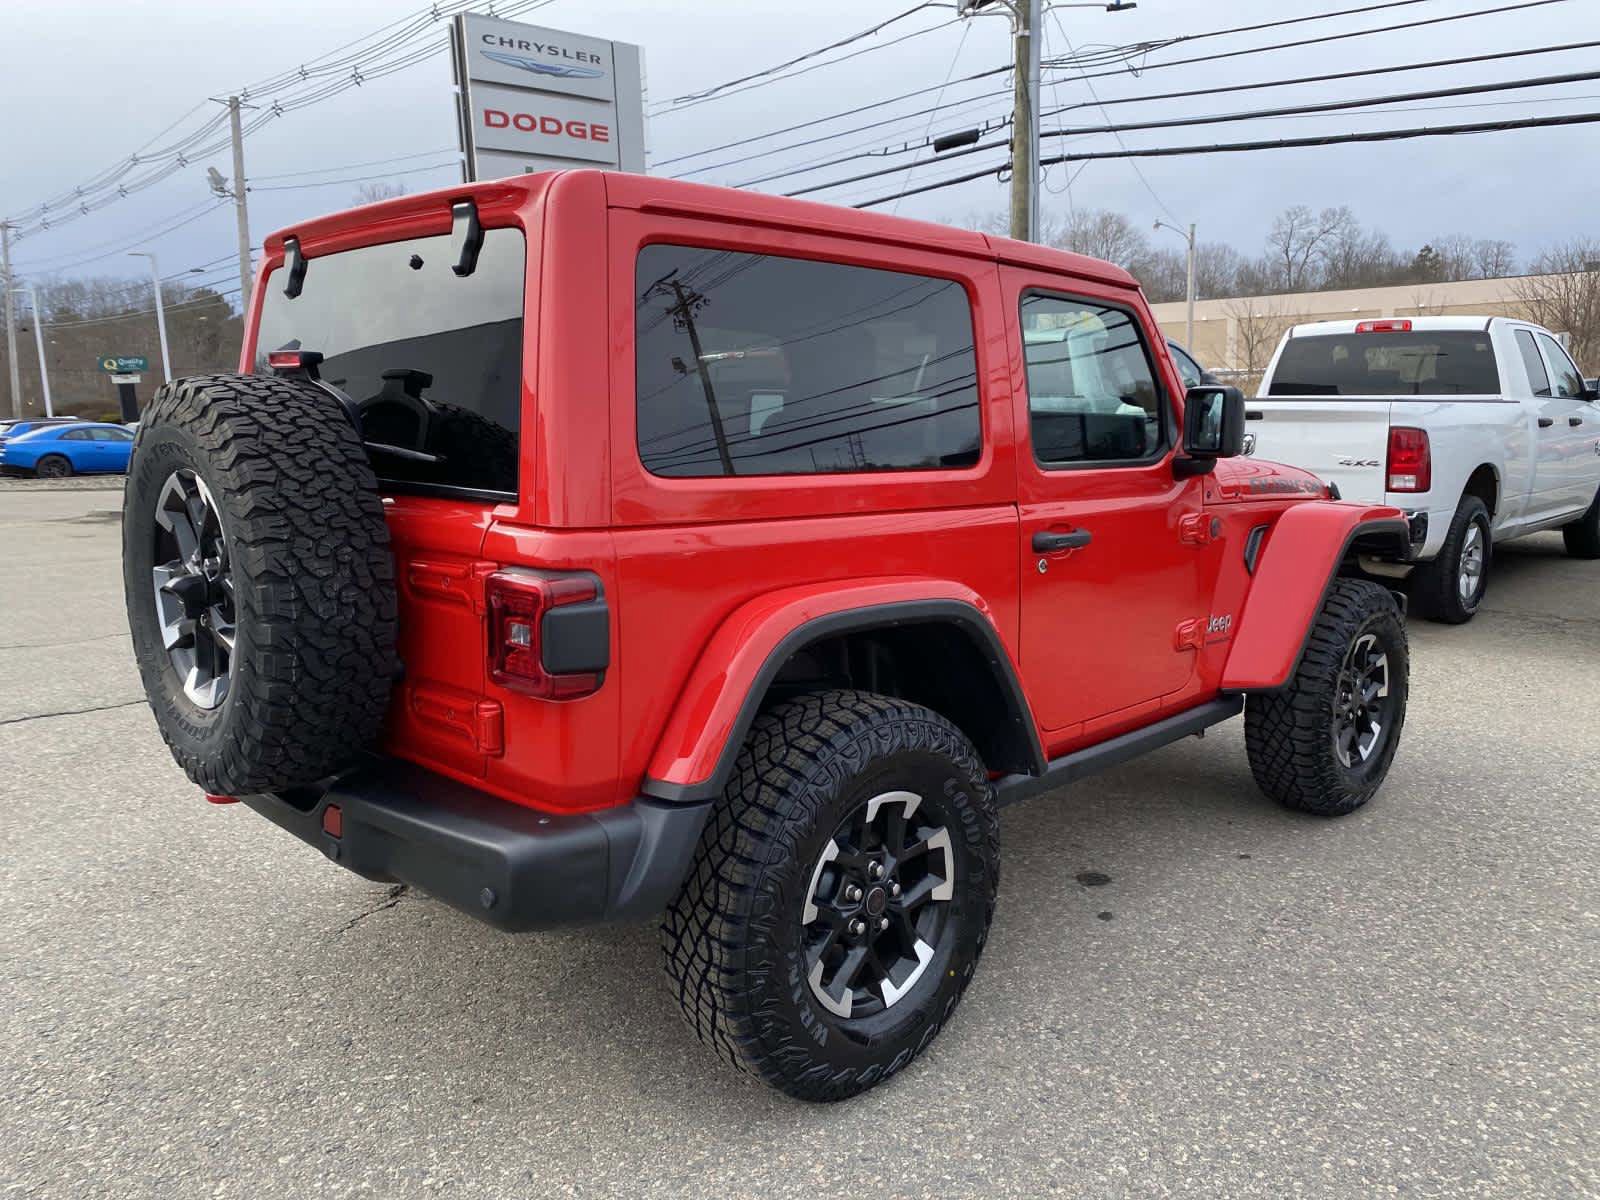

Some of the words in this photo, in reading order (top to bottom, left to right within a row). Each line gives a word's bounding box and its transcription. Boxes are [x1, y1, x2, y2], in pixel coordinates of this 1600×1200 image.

[482, 34, 601, 65] CHRYSLER
[483, 109, 609, 143] DODGE
[118, 358, 143, 366] Quality
[1207, 614, 1232, 633] Jeep
